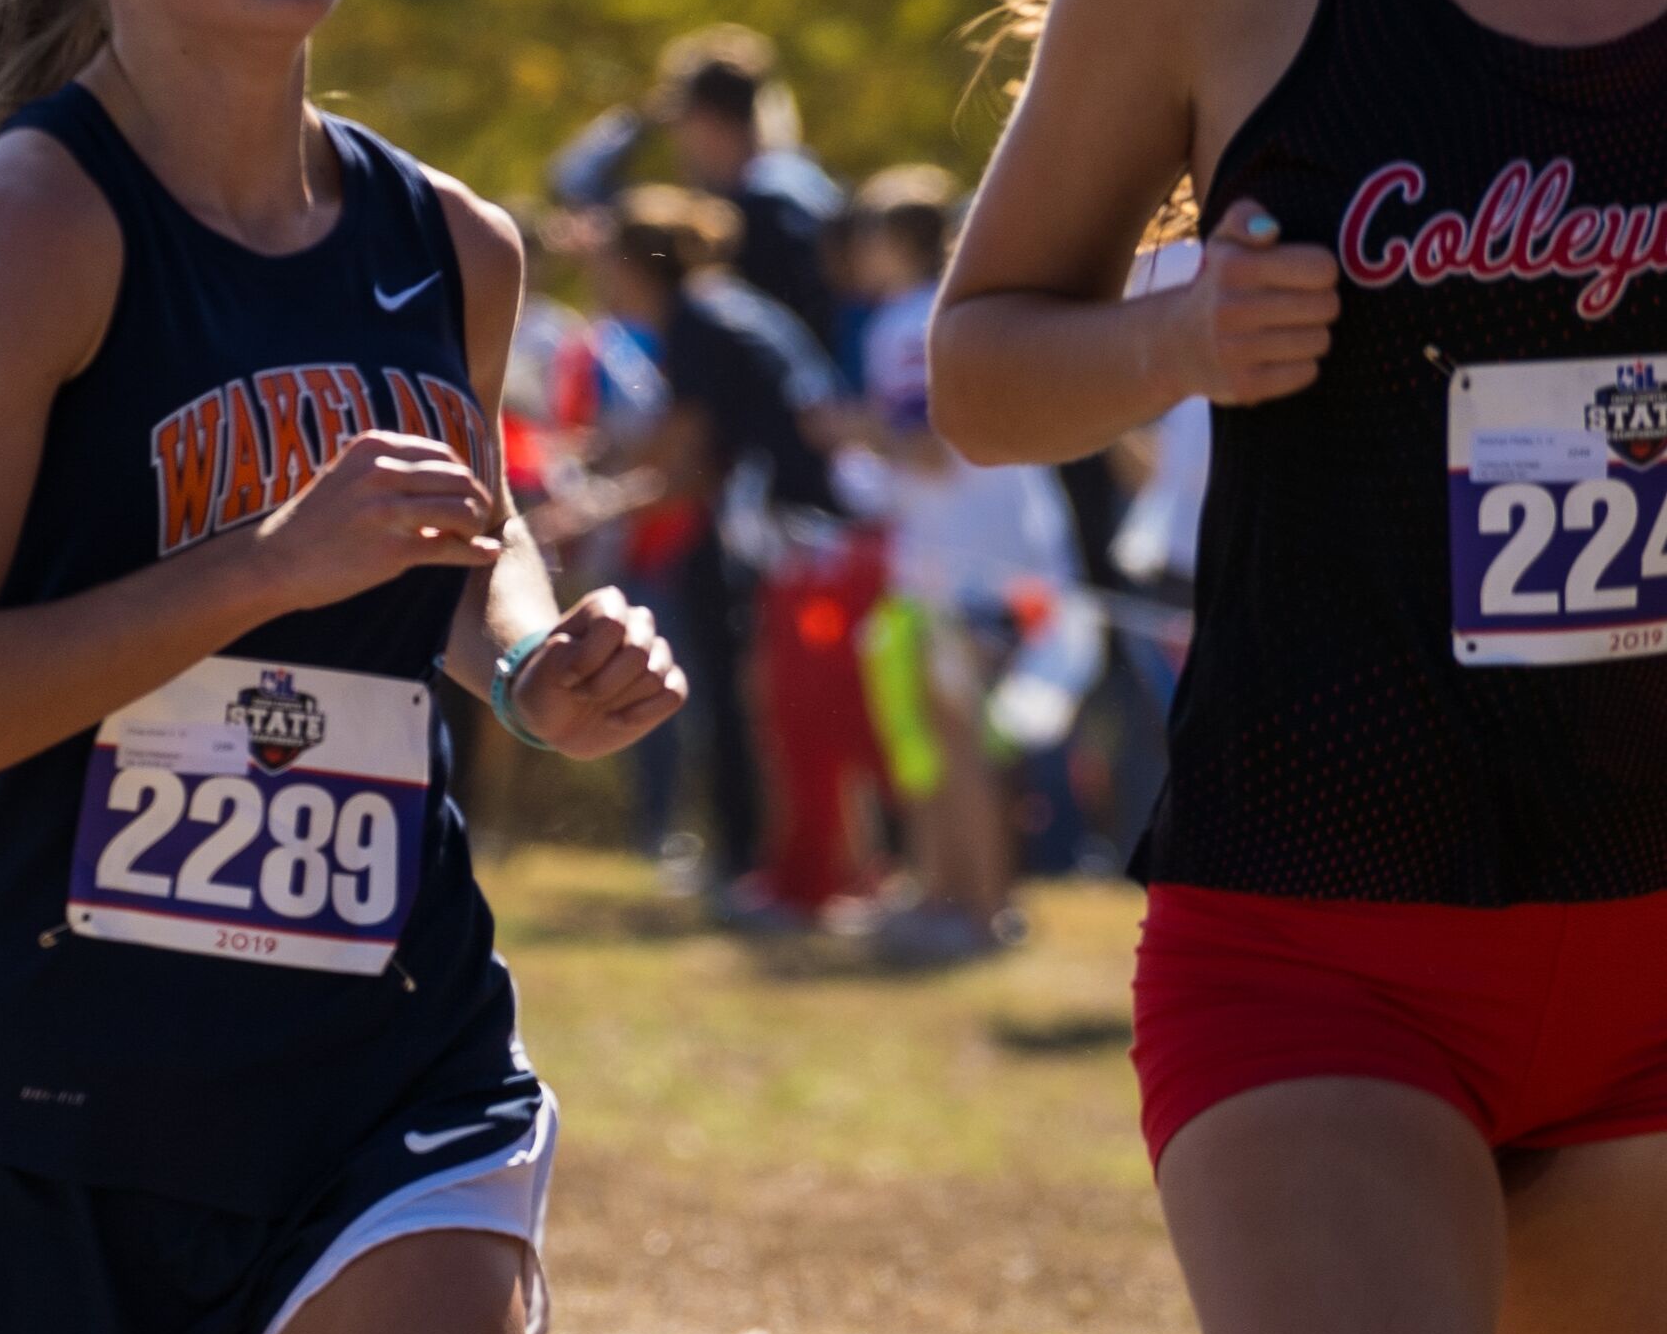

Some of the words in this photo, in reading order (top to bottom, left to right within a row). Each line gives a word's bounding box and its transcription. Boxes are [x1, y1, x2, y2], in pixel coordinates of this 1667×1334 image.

[1338, 157, 1667, 321] Colley
[1610, 629, 1663, 651] 2019
[95, 766, 398, 926] 2289
[214, 930, 279, 954] 2019
